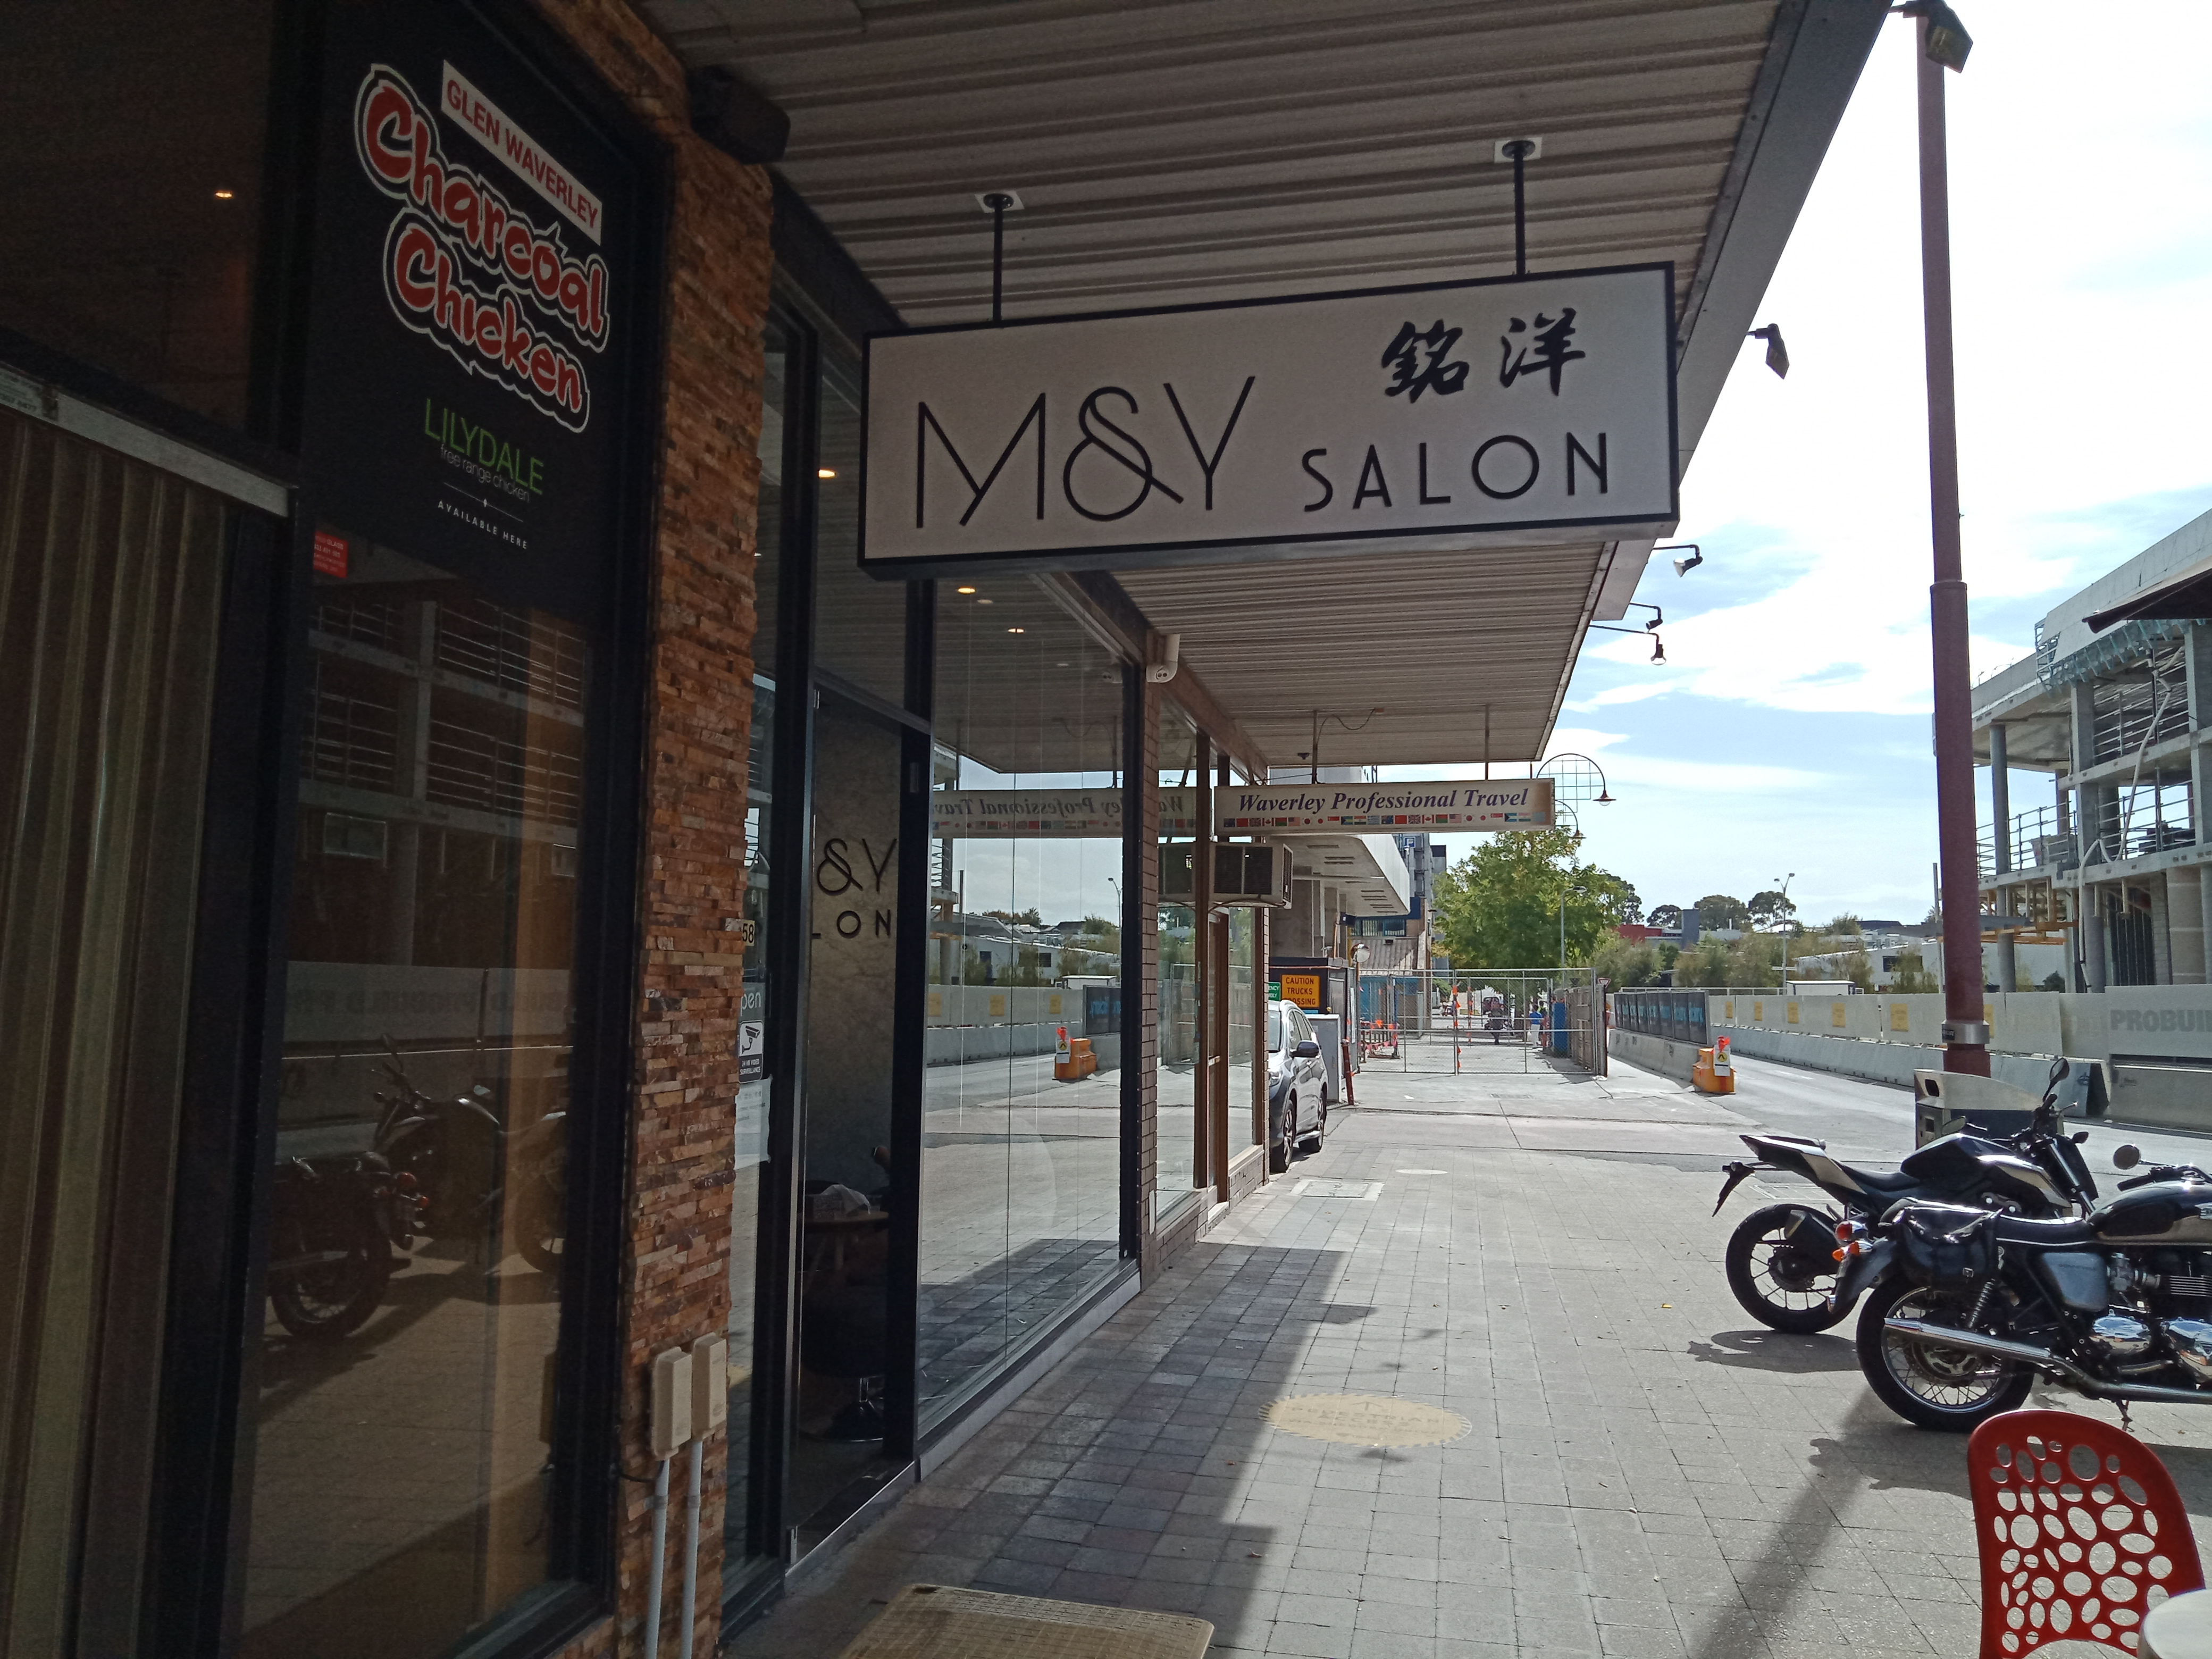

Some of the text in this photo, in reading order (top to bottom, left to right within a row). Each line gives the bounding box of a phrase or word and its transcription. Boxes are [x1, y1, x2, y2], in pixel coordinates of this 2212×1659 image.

[448, 79, 599, 229] GLEN WAVERLEY
[366, 80, 603, 338] Charcoal
[393, 222, 582, 412] Chicken
[424, 398, 544, 496] LILYDALE
[440, 443, 530, 503] free range chicken
[916, 375, 1608, 529] M&Y SALON
[438, 499, 528, 550] AVAILABLE HERE
[1238, 787, 1529, 814] Waverley Professional Travel
[742, 923, 755, 944] 58
[740, 1066, 761, 1075] SURVEILLANCE
[1292, 1407, 1439, 1423] PEDESTRIAN
[1317, 1415, 1410, 1426] ACCESS
